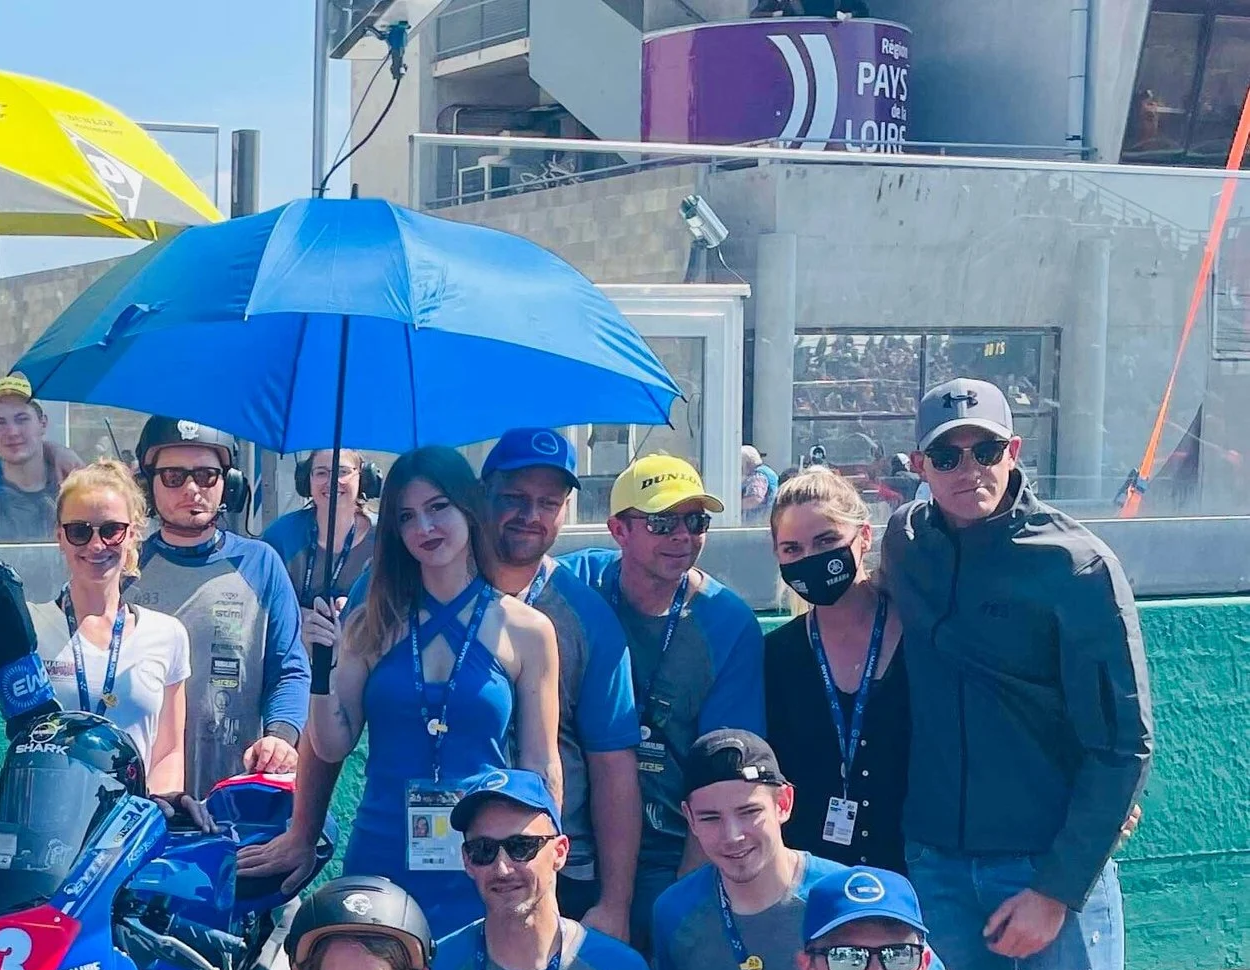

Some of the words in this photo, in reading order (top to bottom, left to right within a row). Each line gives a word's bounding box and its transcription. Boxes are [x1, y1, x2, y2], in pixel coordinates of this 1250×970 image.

[881, 38, 908, 60] Région
[858, 62, 907, 101] PAYS
[891, 104, 901, 119] de
[15, 743, 70, 755] SHARK
